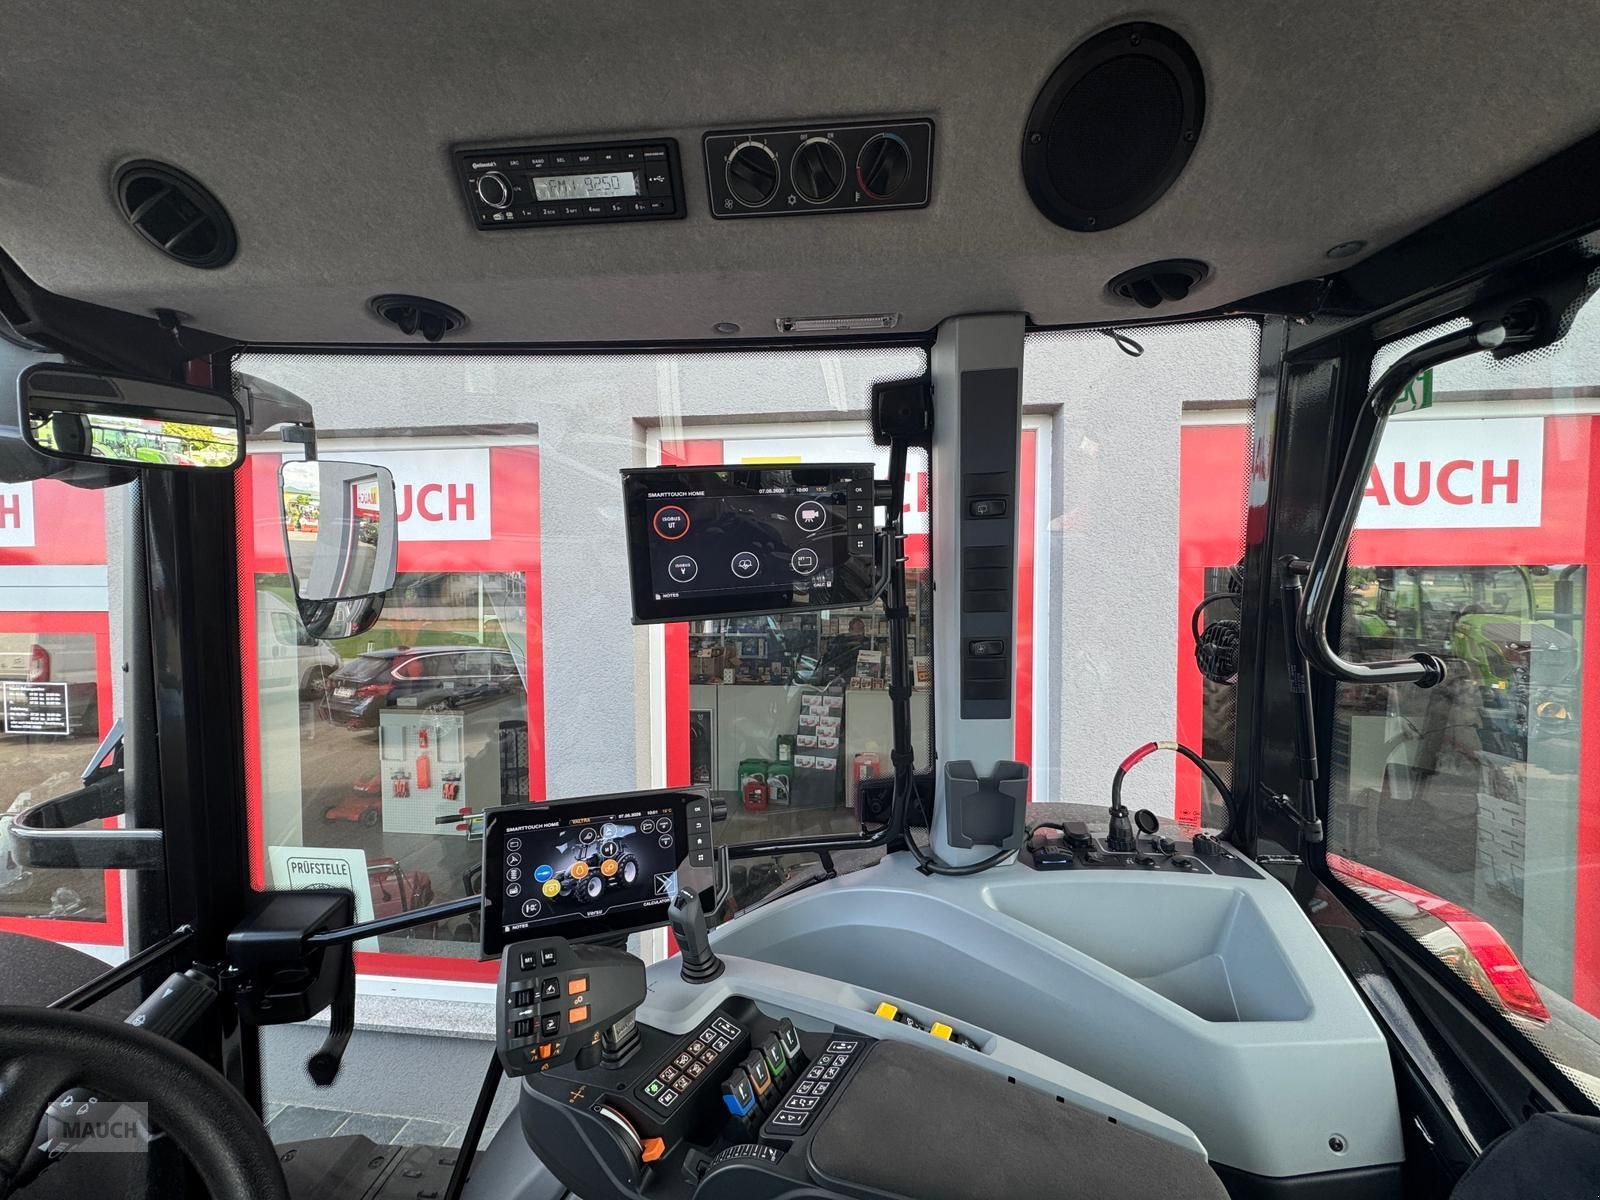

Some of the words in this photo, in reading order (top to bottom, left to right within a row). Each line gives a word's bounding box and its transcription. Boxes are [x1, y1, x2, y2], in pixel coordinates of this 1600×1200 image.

[506, 823, 543, 833] SMARTTOUCH
[543, 821, 560, 829] HOME
[291, 861, 348, 876] PRÜFSTELLE
